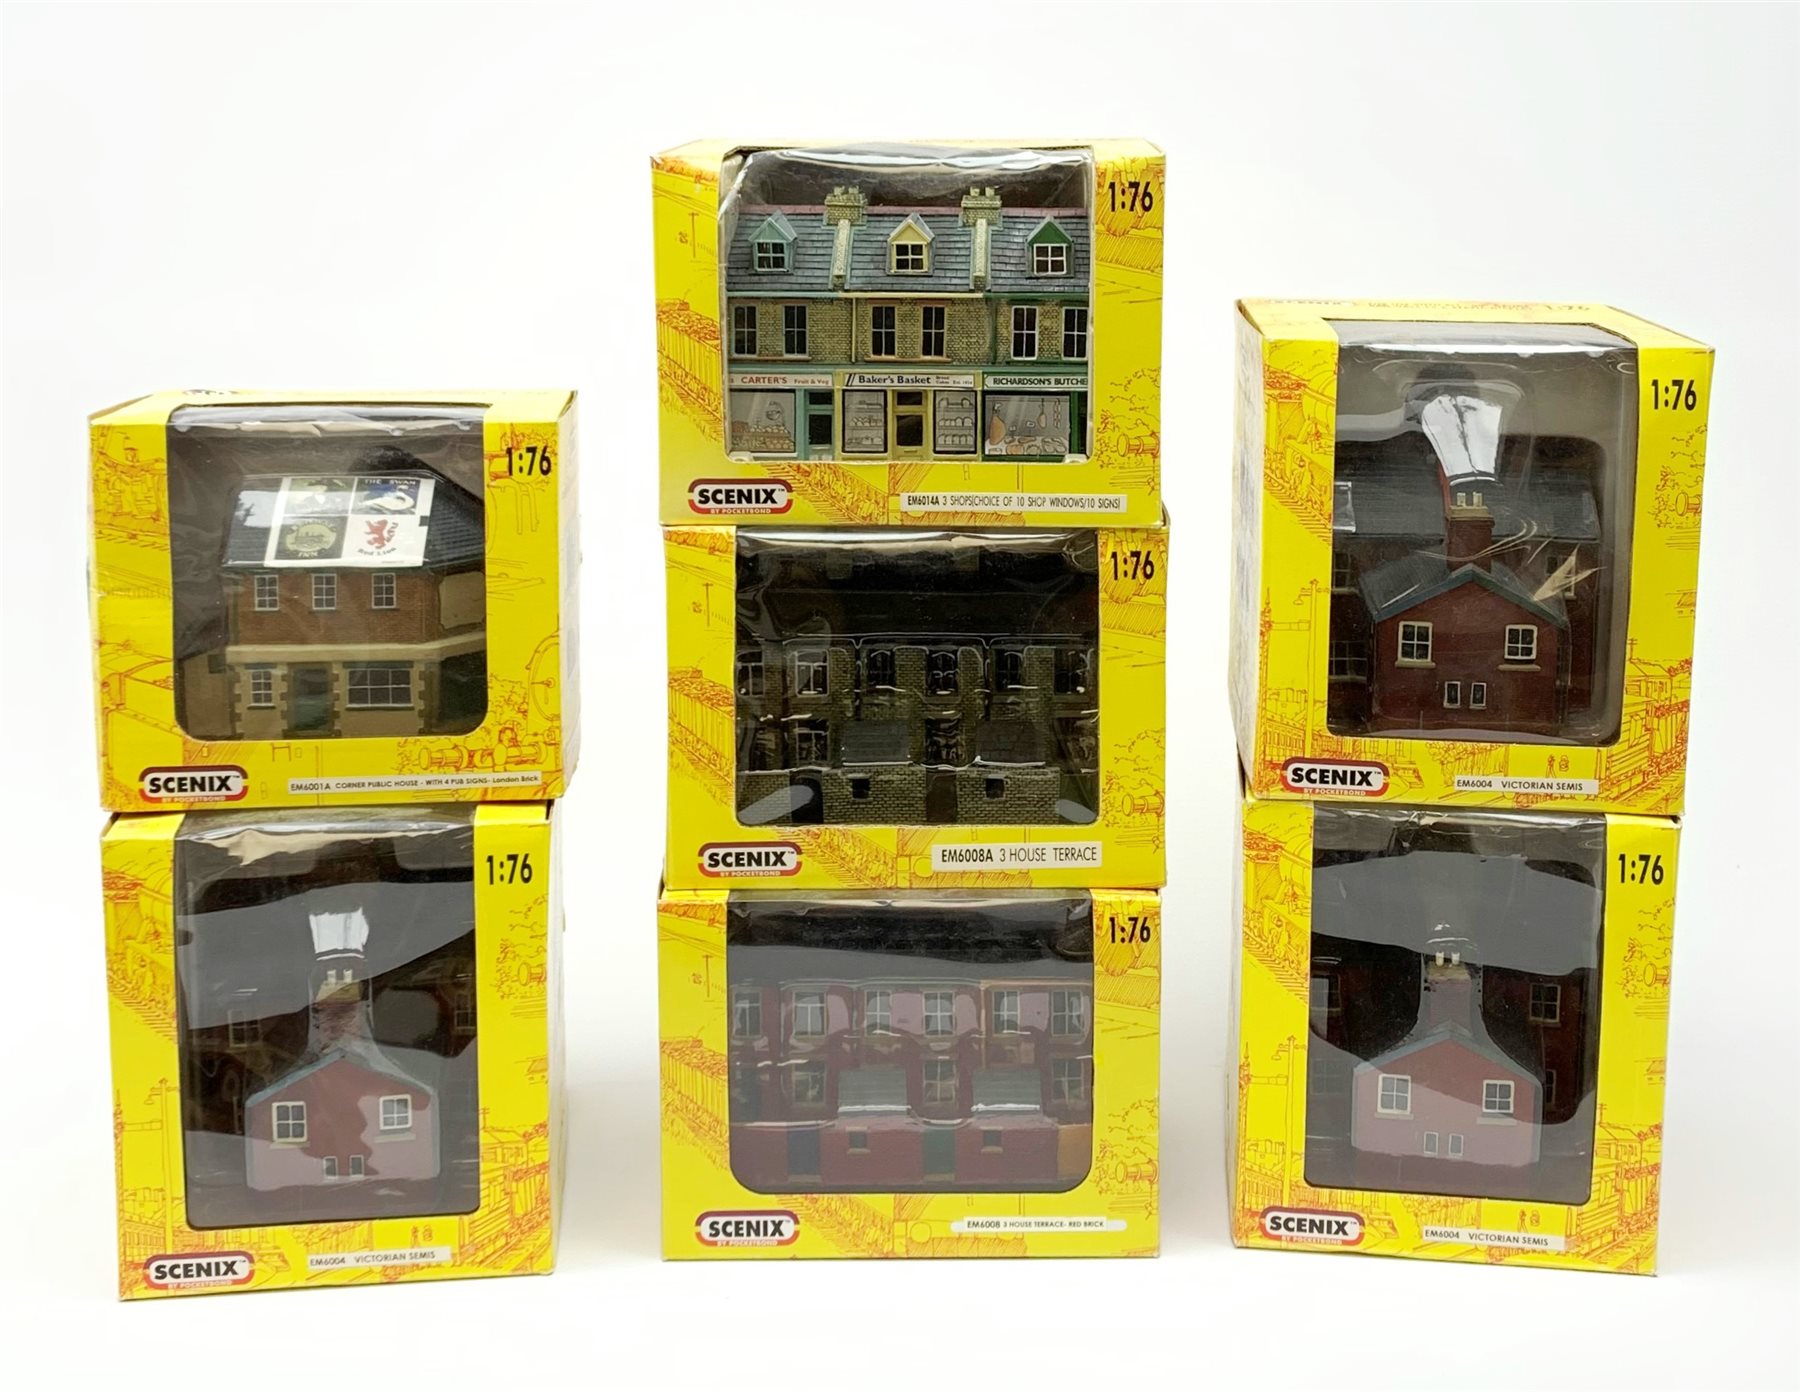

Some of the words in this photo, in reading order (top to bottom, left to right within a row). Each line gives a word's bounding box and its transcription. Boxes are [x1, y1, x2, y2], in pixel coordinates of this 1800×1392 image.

[1108, 181, 1153, 212] 1:76
[741, 376, 787, 384] CARTER'S
[858, 375, 894, 384] Baker's
[897, 375, 931, 384] Basket
[993, 377, 1052, 386] RICHARDSON'S
[1651, 379, 1697, 411] 1:76
[505, 445, 552, 477] 1:76
[698, 488, 777, 504] SCENIX
[907, 495, 940, 506] EM6014A
[942, 495, 948, 506] 3
[1002, 495, 1013, 506] OF
[1017, 496, 1025, 507] 10
[1027, 496, 1047, 507] SHOP
[1110, 550, 1155, 580] 1:76
[149, 775, 232, 794] SCENIX
[291, 782, 331, 791] EM6001A
[335, 781, 366, 789] CORNER
[367, 780, 392, 788] PUBLIC
[1291, 767, 1373, 787] SCENIX
[1456, 780, 1493, 788] EM6004
[1501, 780, 1553, 790] VICTORIAN
[1556, 782, 1583, 791] SEMIS
[1315, 788, 1366, 796] POCKETBOND
[708, 851, 787, 868] SCENIX
[941, 848, 994, 863] EM6008A
[999, 848, 1006, 862] 3
[1009, 847, 1047, 862] HOUSE
[1052, 846, 1097, 862] TERRACE
[486, 853, 533, 885] 1:76
[1618, 853, 1664, 885] 1:76
[1109, 916, 1151, 944] 1:76
[709, 1220, 784, 1238] SCENIX
[967, 1220, 1000, 1229] EM6008
[1269, 1215, 1349, 1236] SCENIX
[1425, 1229, 1460, 1239] EM6004
[1468, 1232, 1519, 1243] VICTORIAN
[1522, 1236, 1548, 1246] SEMIS
[310, 1257, 346, 1266] EM6004
[354, 1252, 406, 1263] VICTORIAN
[409, 1251, 435, 1260] SEMIS
[154, 1260, 238, 1280] SCENIX
